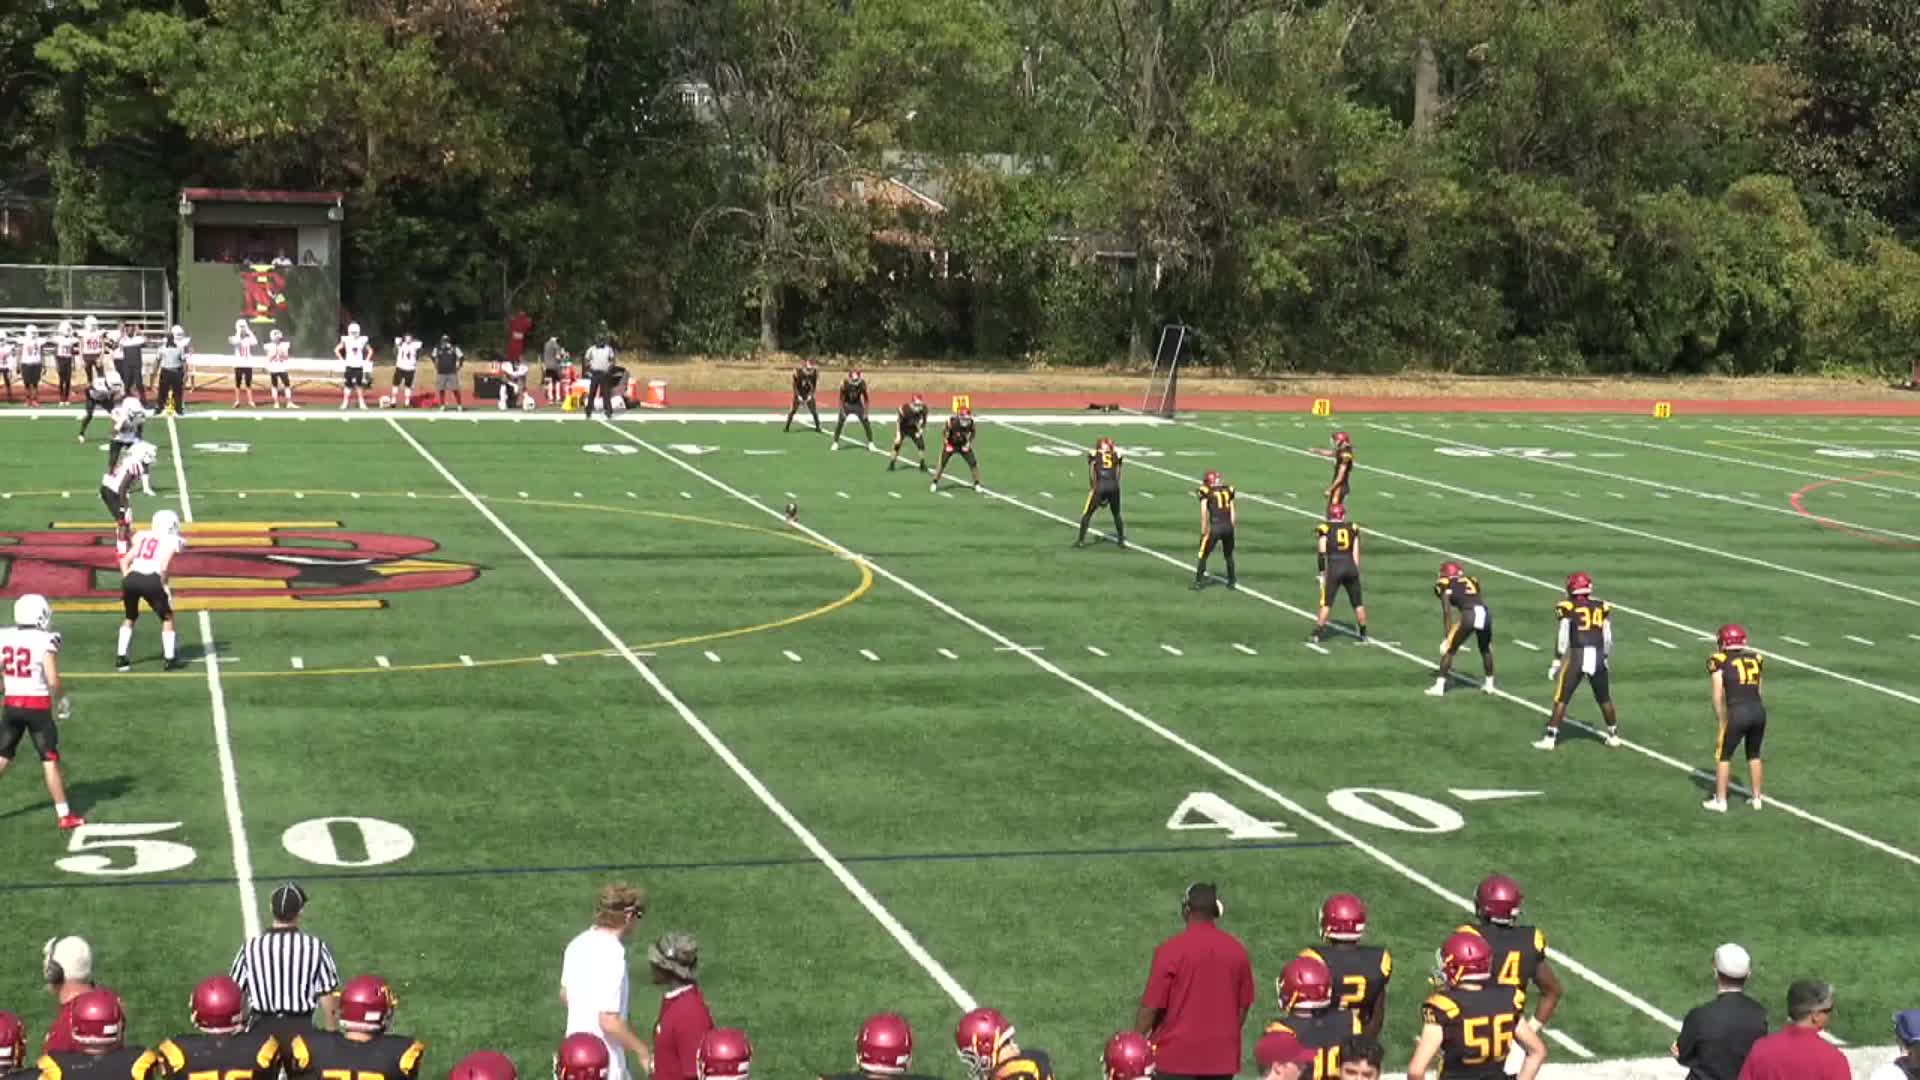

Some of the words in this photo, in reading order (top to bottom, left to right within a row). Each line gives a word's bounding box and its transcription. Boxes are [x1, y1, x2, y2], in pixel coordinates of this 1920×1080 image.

[1102, 453, 1113, 469] 5
[1215, 490, 1231, 512] 11
[137, 537, 159, 561] 19
[1336, 528, 1350, 549] 9
[1463, 577, 1477, 594] 3
[1575, 607, 1604, 631] 34
[1, 645, 32, 678] 22
[1731, 659, 1760, 685] 12
[1462, 1013, 1515, 1064] 56
